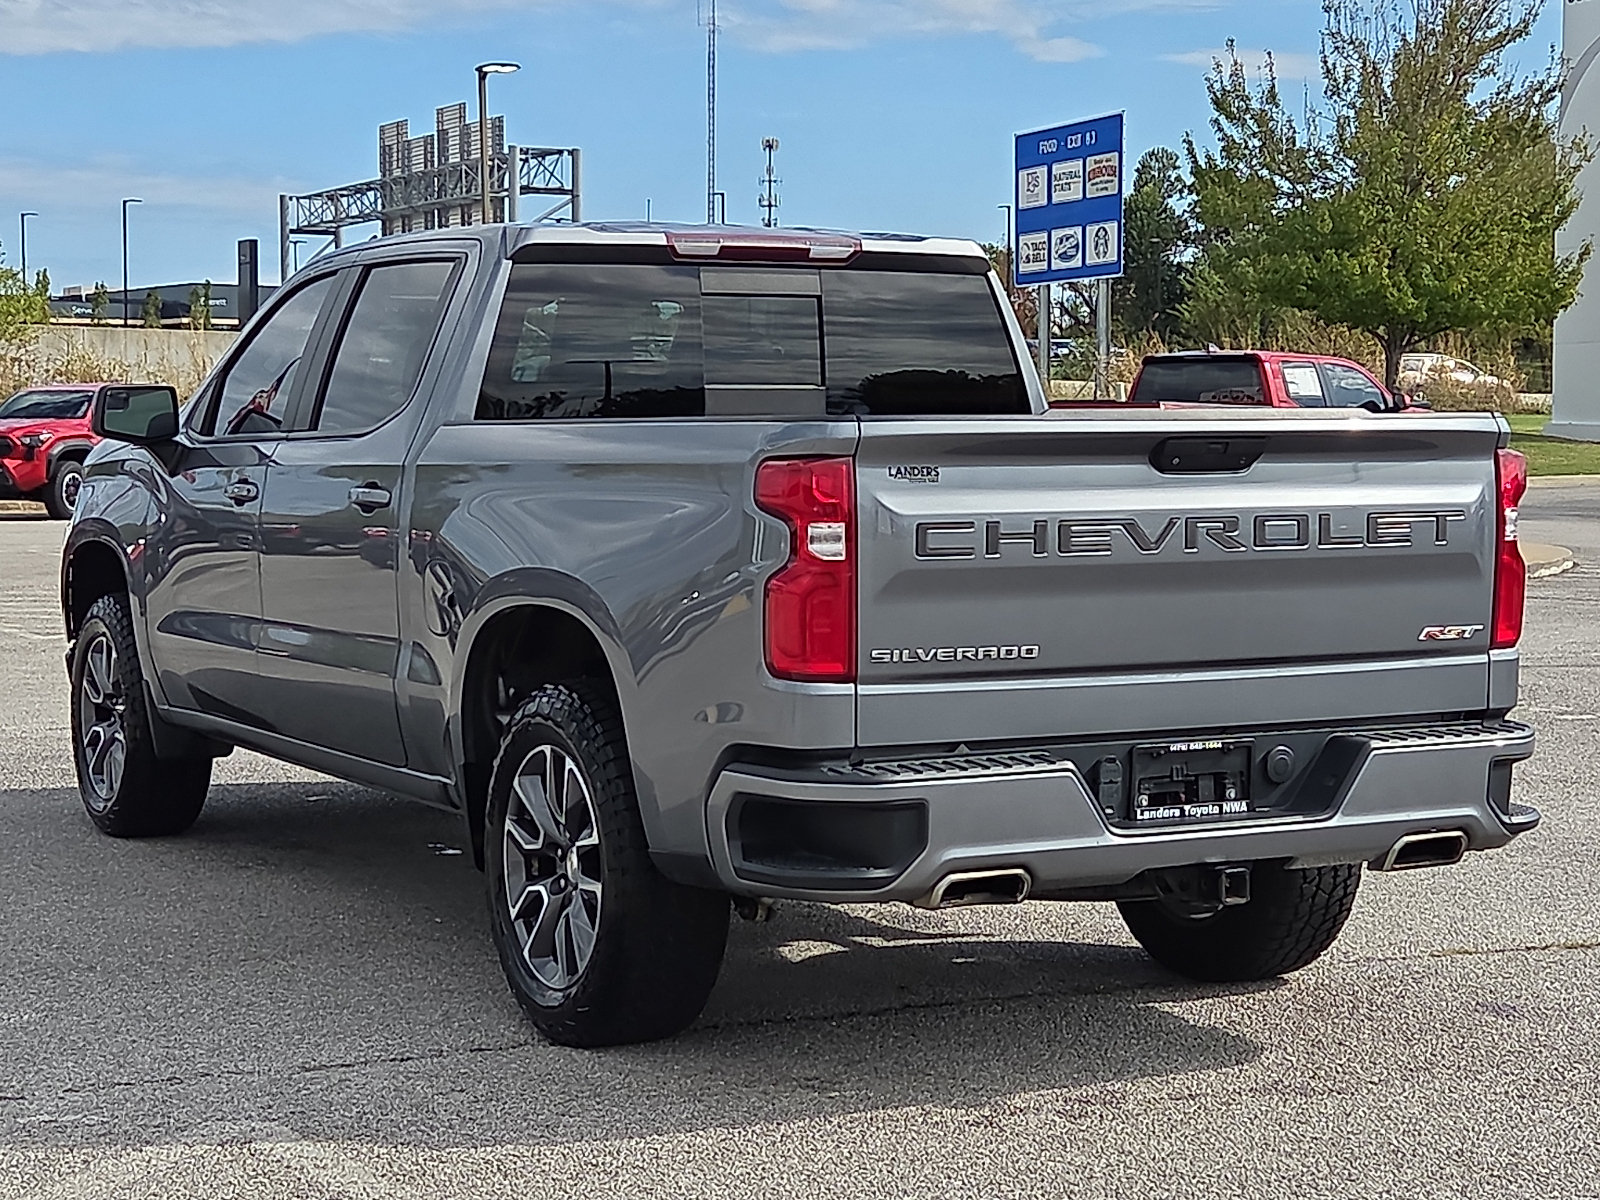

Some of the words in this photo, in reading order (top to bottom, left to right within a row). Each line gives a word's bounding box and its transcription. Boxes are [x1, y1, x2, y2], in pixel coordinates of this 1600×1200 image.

[1031, 241, 1047, 252] TACO
[1032, 251, 1047, 263] BELL
[888, 465, 940, 479] LANDERS
[914, 510, 1466, 559] CHEVROLET
[1418, 624, 1484, 641] RST
[870, 645, 1040, 663] SILVERADO
[1137, 807, 1180, 819] Landers
[1183, 803, 1219, 817] Toyota
[1223, 801, 1248, 813] NWA
